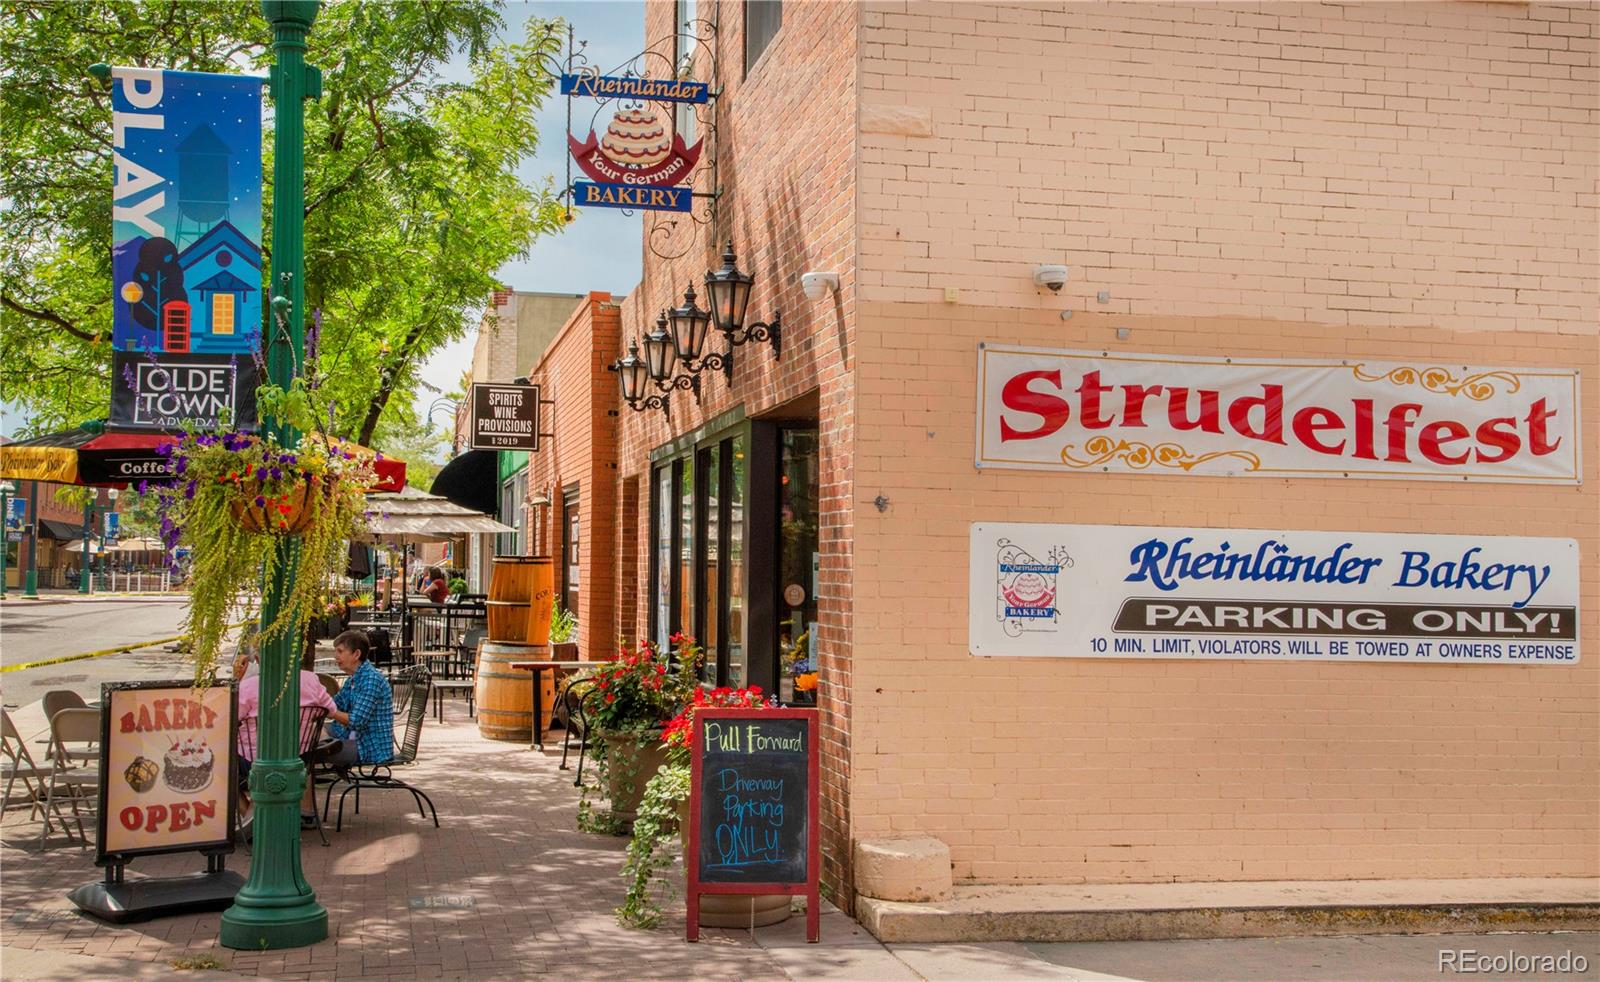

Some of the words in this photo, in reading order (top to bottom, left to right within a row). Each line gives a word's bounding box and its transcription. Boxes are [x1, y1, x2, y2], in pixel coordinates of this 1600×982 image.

[570, 65, 703, 98] Rheinländer
[112, 66, 166, 237] PLAY
[589, 151, 620, 180] Your
[623, 157, 684, 185] German
[586, 185, 682, 207] BAKERY
[147, 368, 225, 392] OLDE
[140, 393, 230, 416] TOWN
[489, 393, 523, 407] SPIRITS
[494, 406, 517, 419] WINE
[478, 419, 532, 433] PROVISIONS
[1000, 369, 1562, 465] Strudelfest
[497, 437, 518, 445] 2019
[1123, 537, 1383, 591] Rheinländer
[1392, 547, 1551, 608] Bakery
[1009, 608, 1048, 616] BAKERY
[1146, 604, 1386, 630] PARKING
[1413, 610, 1560, 633] ONLY!
[1090, 637, 1107, 652] 10
[1114, 638, 1146, 653] MIN.
[1153, 639, 1195, 656] LIMIT,
[1288, 641, 1323, 655] WILL
[1329, 641, 1349, 655] BE
[1355, 641, 1409, 656] TOWED
[1415, 643, 1432, 656] AT
[1439, 643, 1502, 658] OWNERS
[120, 698, 219, 733] BAKERY
[704, 722, 741, 752] Pull
[748, 725, 803, 754] Forward
[719, 768, 783, 801] Driveway
[119, 800, 217, 833] OPEN
[723, 794, 784, 830] Parking
